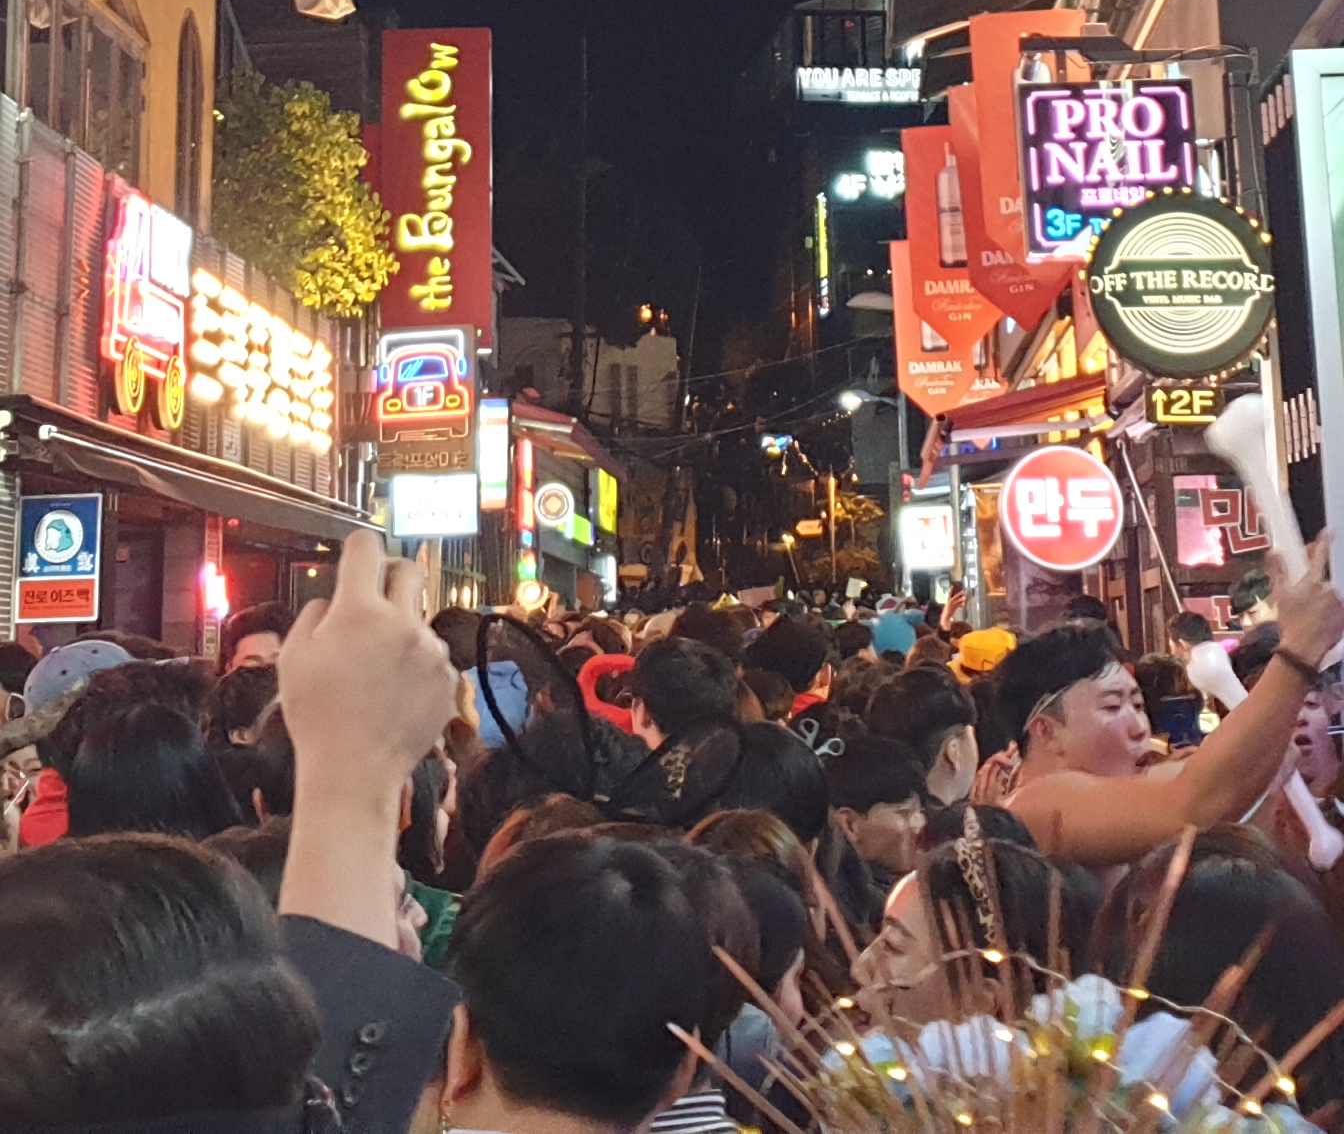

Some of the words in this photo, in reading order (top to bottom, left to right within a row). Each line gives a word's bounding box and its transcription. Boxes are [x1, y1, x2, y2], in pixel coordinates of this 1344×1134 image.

[841, 67, 883, 88] ARE
[1052, 96, 1165, 141] PRO
[1044, 140, 1177, 183] NAIL
[835, 174, 867, 199] 4F
[1045, 208, 1081, 238] 3F
[408, 257, 454, 312] the
[1090, 272, 1127, 294] OFF
[1130, 269, 1177, 290] THE
[908, 361, 963, 374] DAMRAK
[413, 386, 434, 407] 1F
[1170, 389, 1215, 414] 2F
[1015, 478, 1114, 537] 만두
[24, 589, 48, 604] 진로
[50, 589, 75, 603] 이즈
